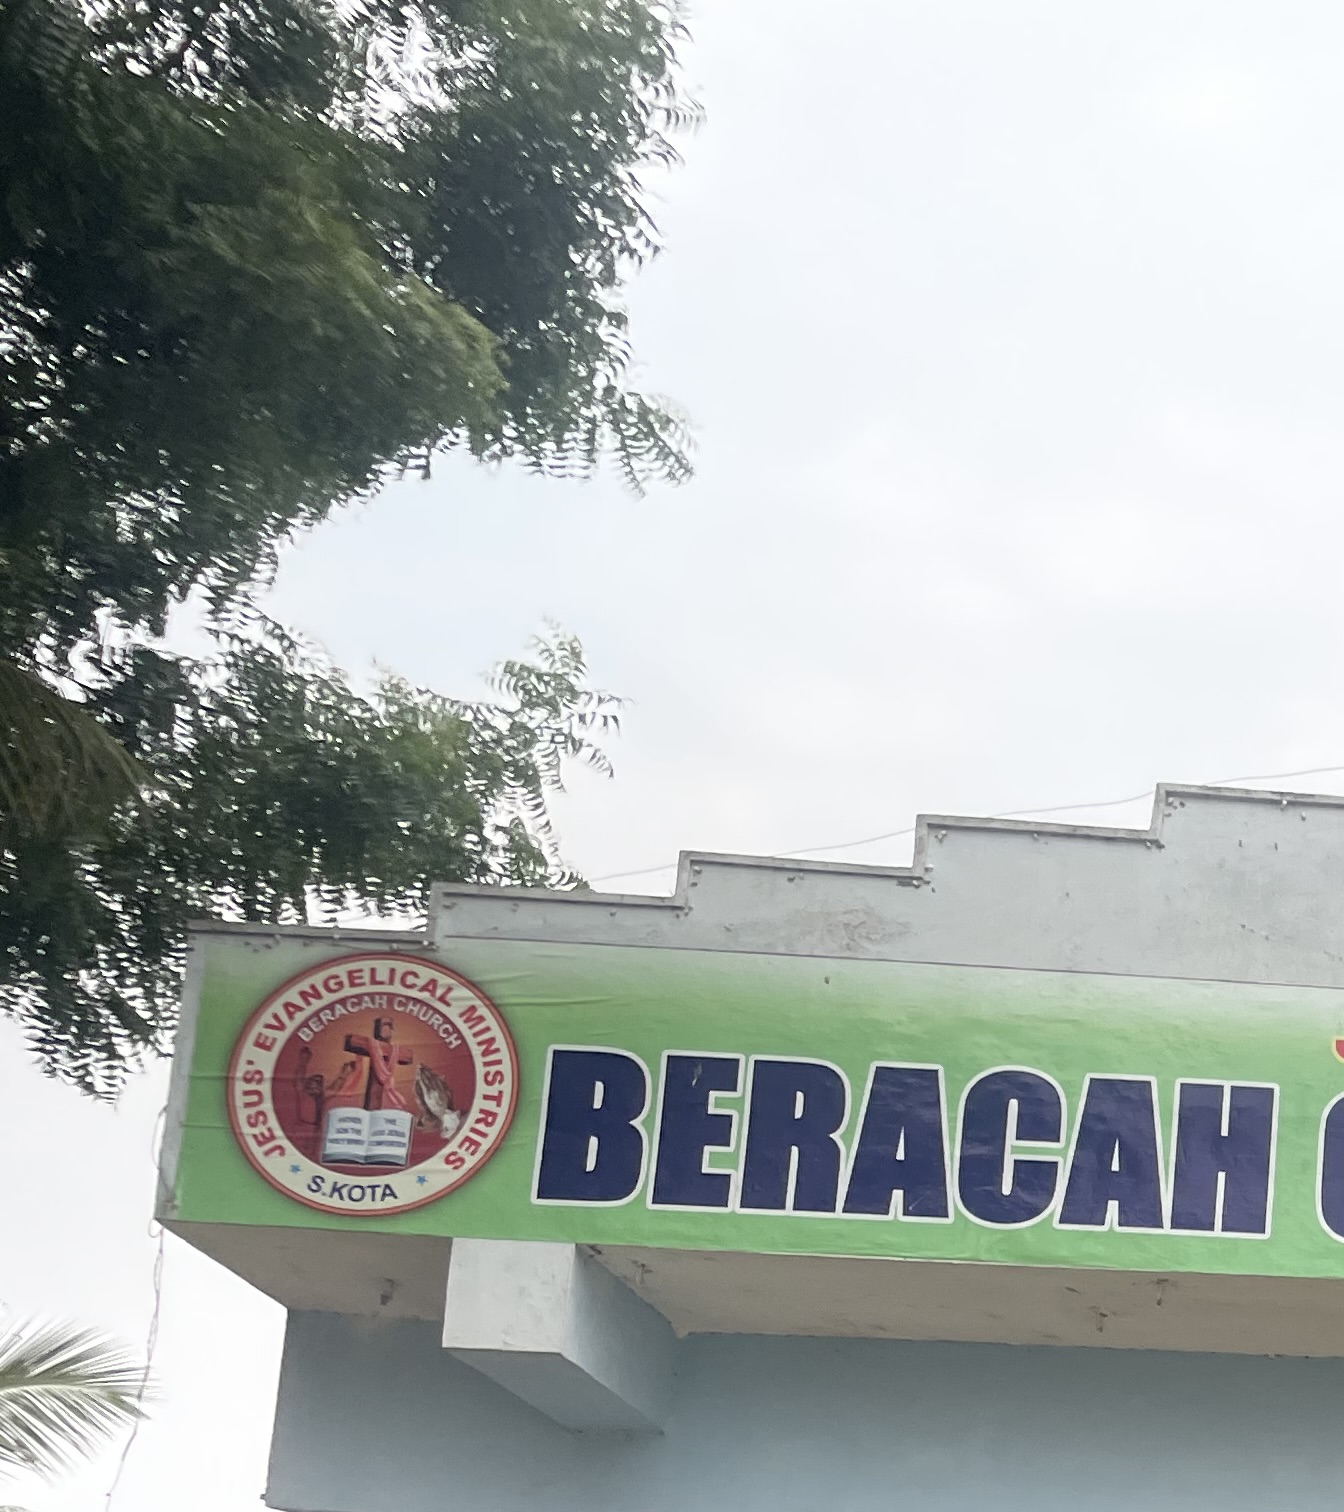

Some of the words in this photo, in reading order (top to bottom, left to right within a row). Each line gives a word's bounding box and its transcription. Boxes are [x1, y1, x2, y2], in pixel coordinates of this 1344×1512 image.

[253, 967, 454, 1052] EVANGELICAL
[444, 1004, 505, 1171] MINISTRIES
[297, 995, 388, 1043] BERACAH
[394, 998, 462, 1050] CHURCH
[307, 1175, 398, 1202] S.KOTA
[531, 1044, 1280, 1239] BERACAH
